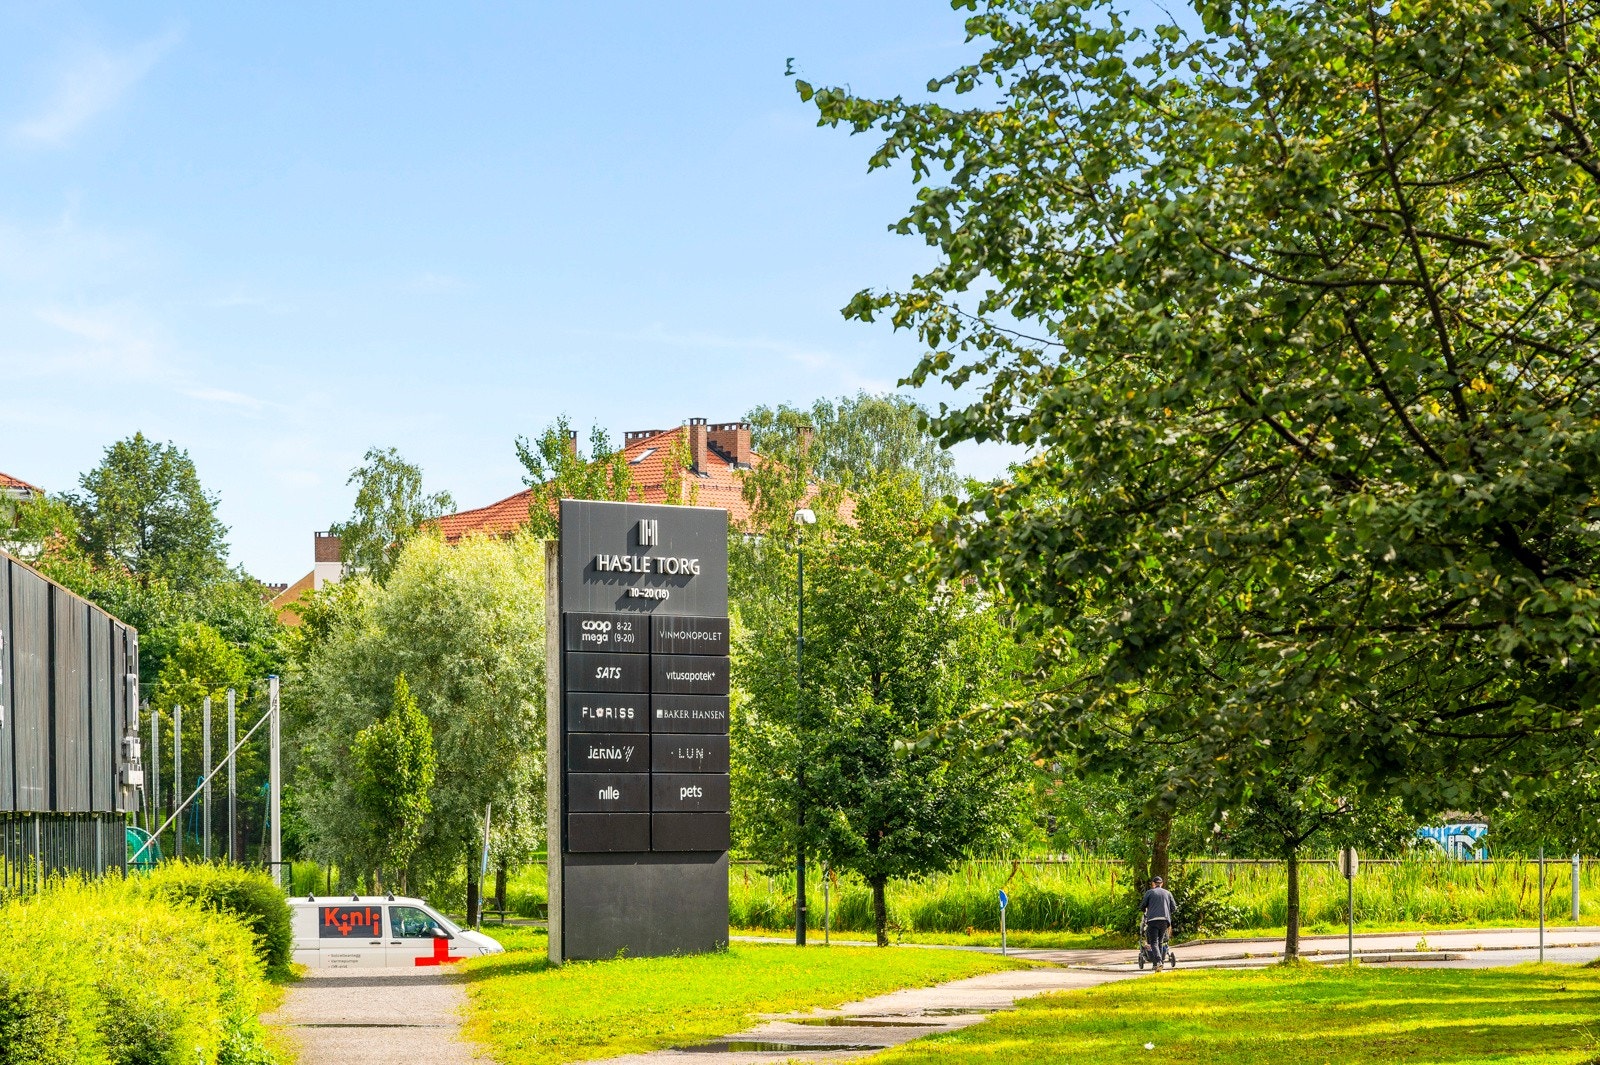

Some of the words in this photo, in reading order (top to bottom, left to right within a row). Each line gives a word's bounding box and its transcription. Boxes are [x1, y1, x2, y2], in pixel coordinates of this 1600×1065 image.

[596, 554, 651, 573] HASLE
[657, 556, 700, 575] TORG
[582, 620, 611, 633] coop
[616, 621, 632, 631] 8-22
[582, 633, 608, 644] mega
[614, 632, 635, 643] (9-20)
[659, 630, 722, 641] VINMONOPOLET
[595, 666, 622, 679] SATS
[582, 706, 635, 719] FLORISS
[664, 709, 690, 719] BAKER
[692, 710, 725, 719] HANSEN
[678, 748, 704, 759] LUN
[598, 785, 620, 800] nille
[680, 785, 703, 801] pets
